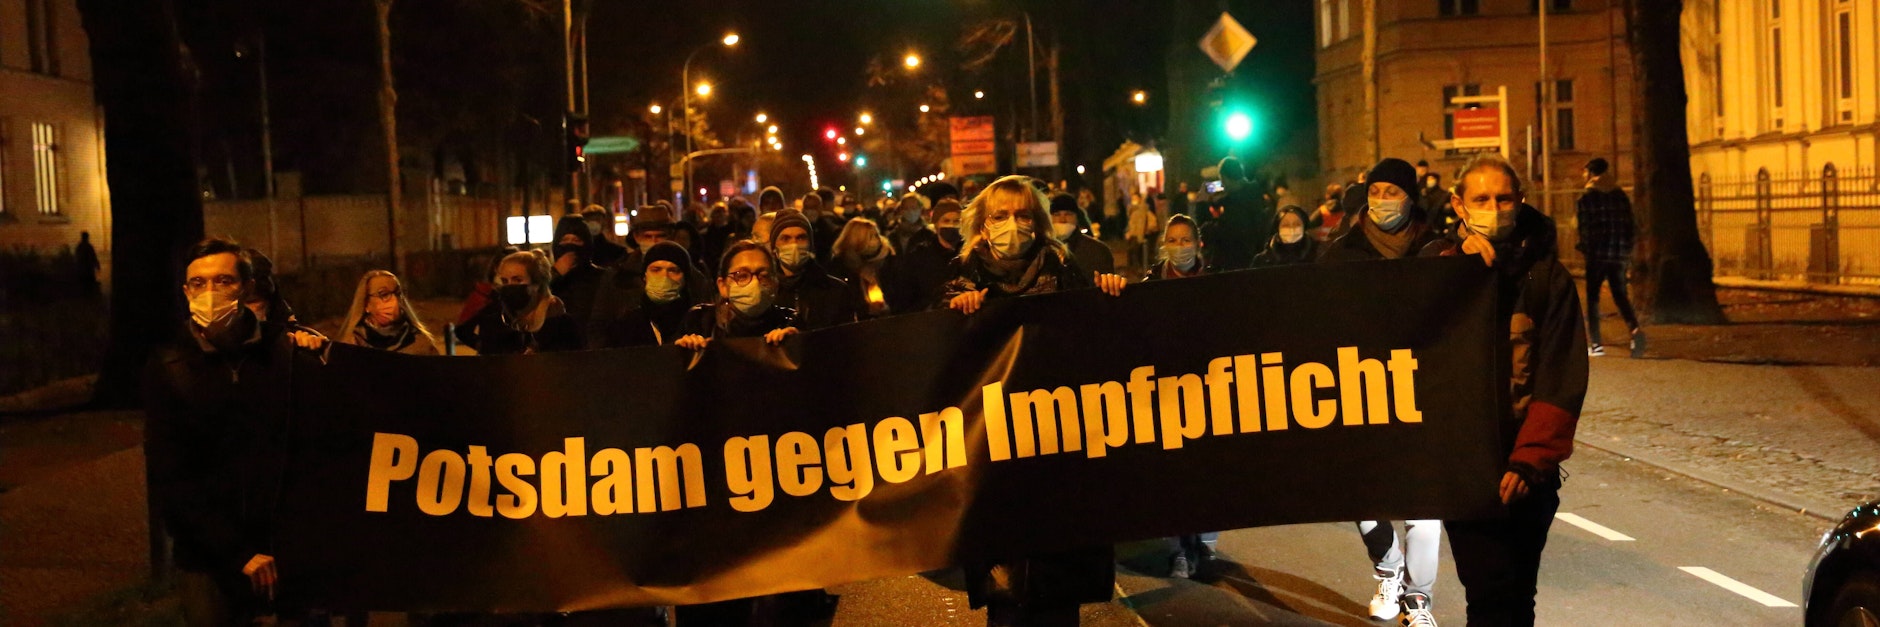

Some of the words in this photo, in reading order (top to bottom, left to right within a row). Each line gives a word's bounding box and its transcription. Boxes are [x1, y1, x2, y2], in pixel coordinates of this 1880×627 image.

[365, 432, 707, 519] Potsdam
[723, 405, 968, 513] gegen
[981, 346, 1423, 462] Impfpflicht
